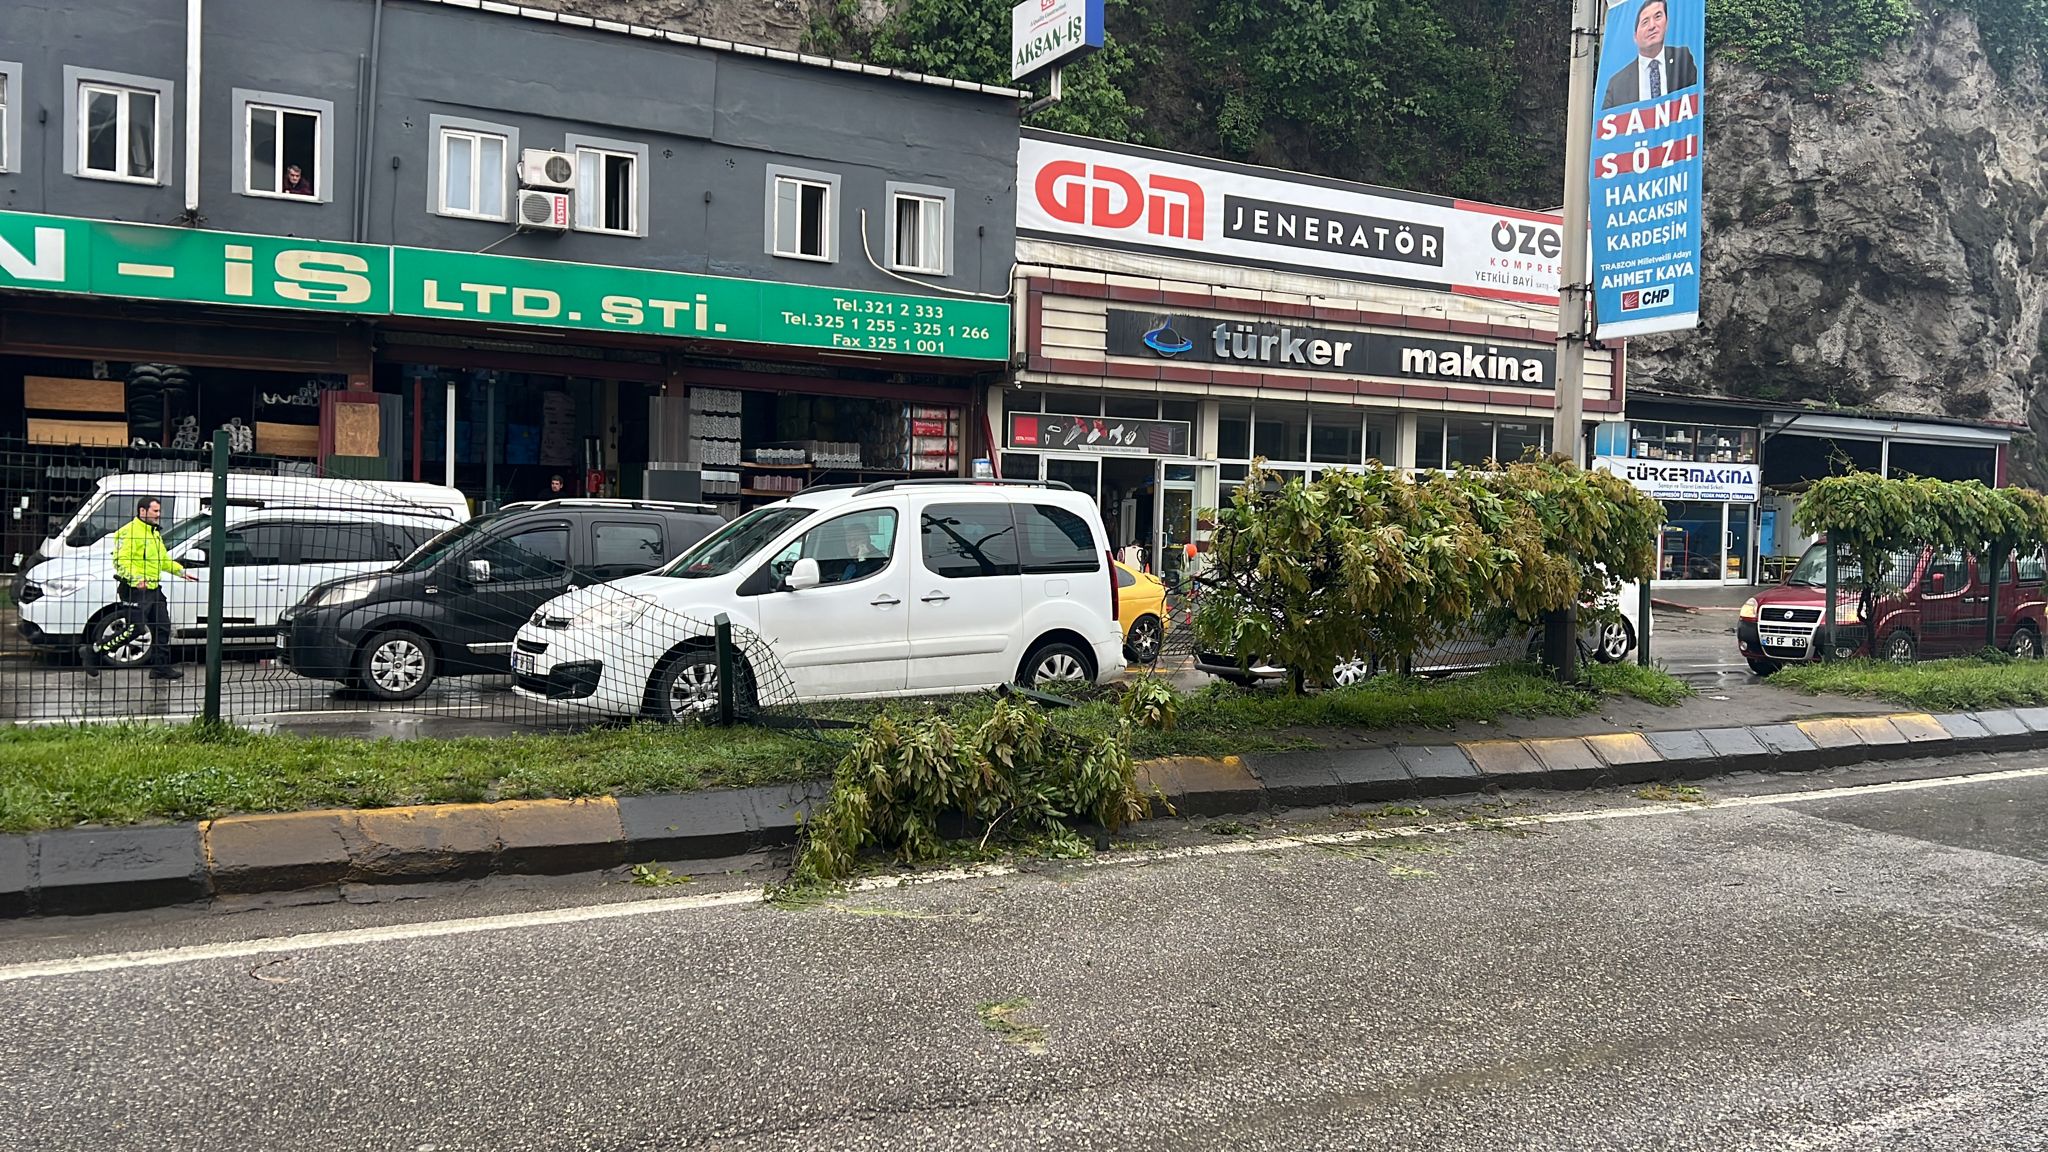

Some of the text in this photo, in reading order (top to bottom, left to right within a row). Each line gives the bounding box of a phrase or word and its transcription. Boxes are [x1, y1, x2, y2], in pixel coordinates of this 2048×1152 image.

[1601, 94, 1693, 140] SANA
[1601, 134, 1692, 179] SÖZ!
[1606, 172, 1688, 207] HAKKINI
[1035, 160, 1438, 259] GDM JENERATÖR
[1606, 198, 1688, 228] ALACAKSIN
[1607, 221, 1687, 251] KARDEŞİM
[1475, 271, 1509, 284] YETKİLİ
[1512, 275, 1533, 287] BAYİ
[1490, 257, 1561, 275] KOMPRES
[1601, 260, 1636, 271] TRABZON
[1601, 262, 1694, 289] AHMET KAYA
[423, 280, 582, 321] LTD.
[1642, 289, 1669, 305] CHP
[900, 304, 909, 316] 2
[915, 305, 943, 319] 333
[852, 318, 858, 329] 1
[866, 319, 895, 332] 255
[913, 323, 941, 335] 325
[948, 325, 955, 336] 1
[962, 326, 990, 339] 266
[832, 334, 945, 353] Fax 325 1 001
[1212, 323, 1544, 382] türker makina
